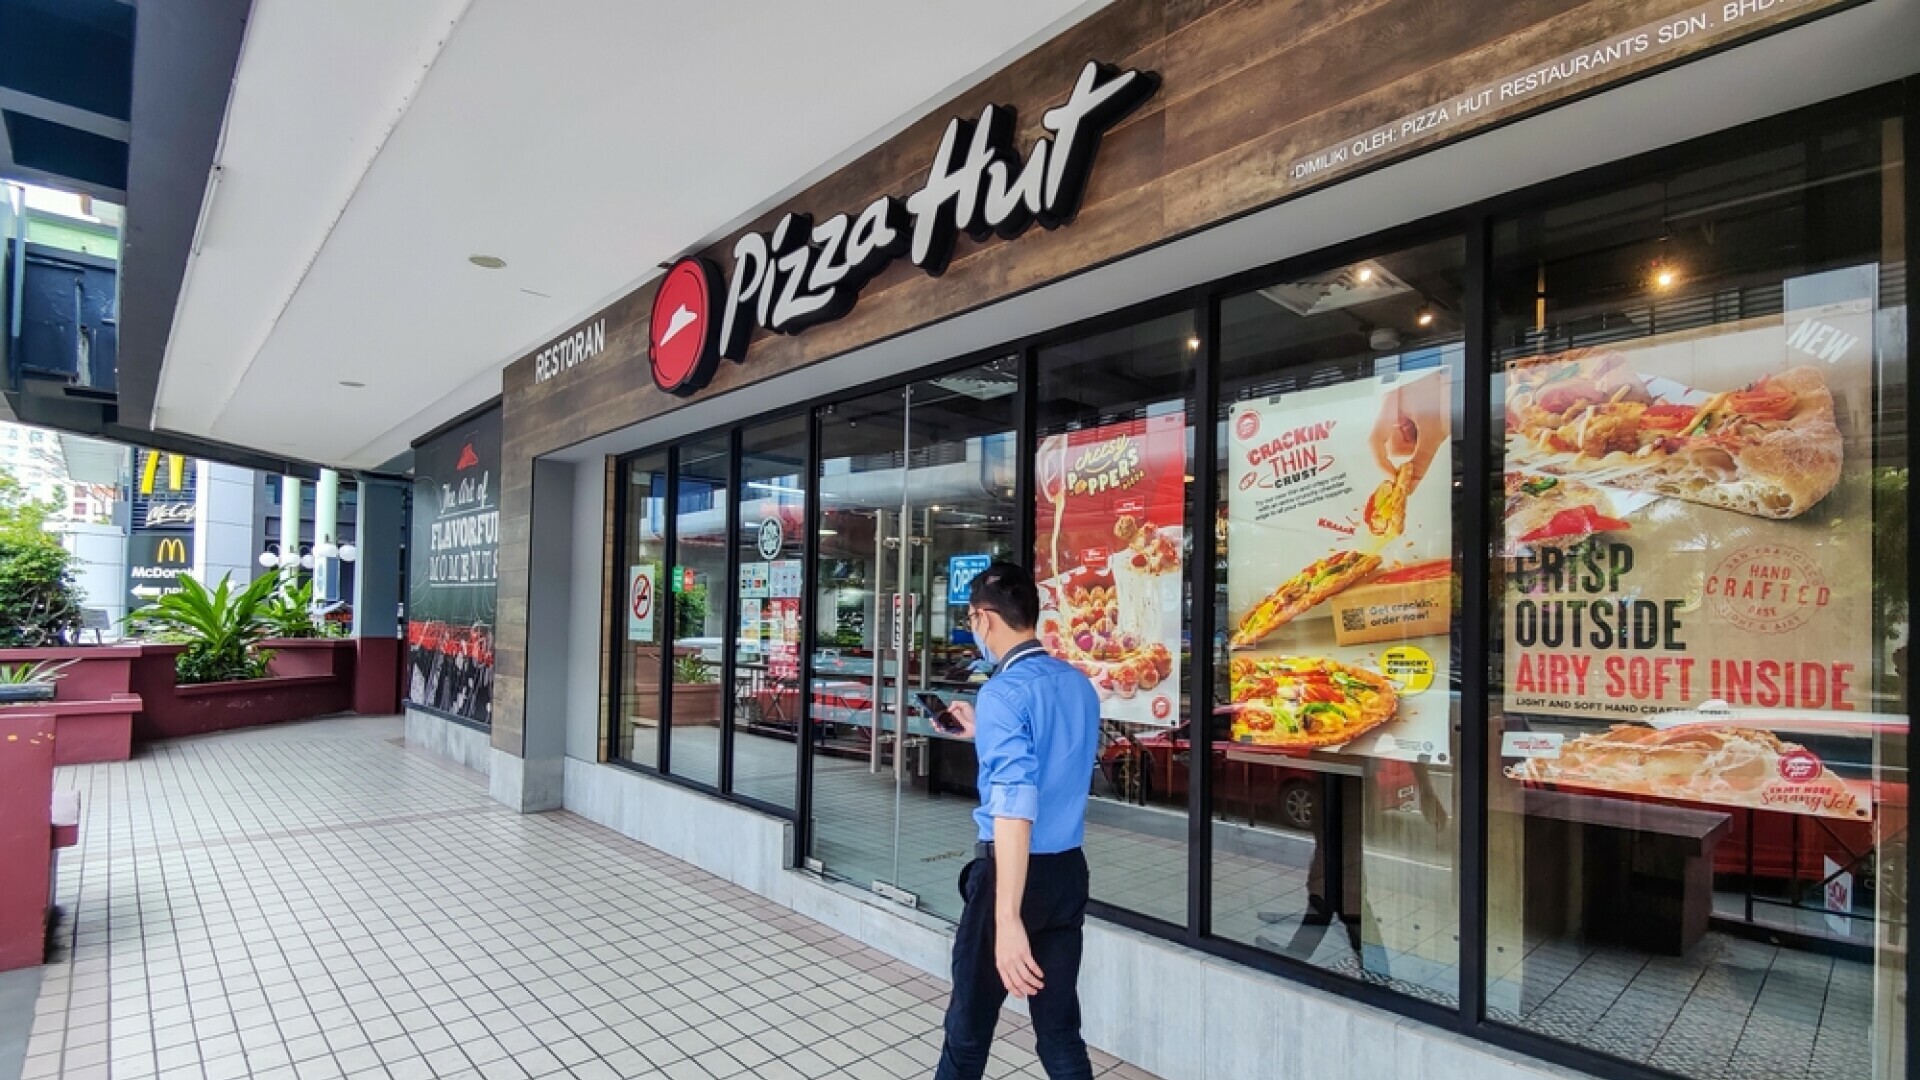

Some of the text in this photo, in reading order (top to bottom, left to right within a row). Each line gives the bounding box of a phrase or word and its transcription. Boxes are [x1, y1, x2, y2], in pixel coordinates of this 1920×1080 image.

[1294, 147, 1348, 179] DIMILIKI
[1352, 128, 1397, 156] OLEH:
[1401, 107, 1449, 137] PIZZA
[1456, 89, 1493, 116] HUT
[1500, 33, 1649, 101] RESTAURANTS
[1657, 12, 1715, 44] SDN.
[719, 59, 1139, 357] Pizza Hut
[535, 318, 606, 385] RESTORAN
[1785, 317, 1860, 364] NEW
[1268, 444, 1318, 478] THIN
[1275, 466, 1317, 488] CRUST
[1515, 541, 1635, 594] CRISP
[1705, 575, 1830, 606] CRAFTED
[1749, 564, 1791, 581] HAND
[1370, 615, 1399, 626] order
[1515, 598, 1687, 651] OUTSIDE
[1515, 653, 1855, 711] AIRY SOFT INSIDE
[1516, 698, 1545, 708] LIGHT
[1549, 699, 1571, 709] AND
[1574, 701, 1602, 711] SOFT
[1604, 703, 1639, 714] HAND
